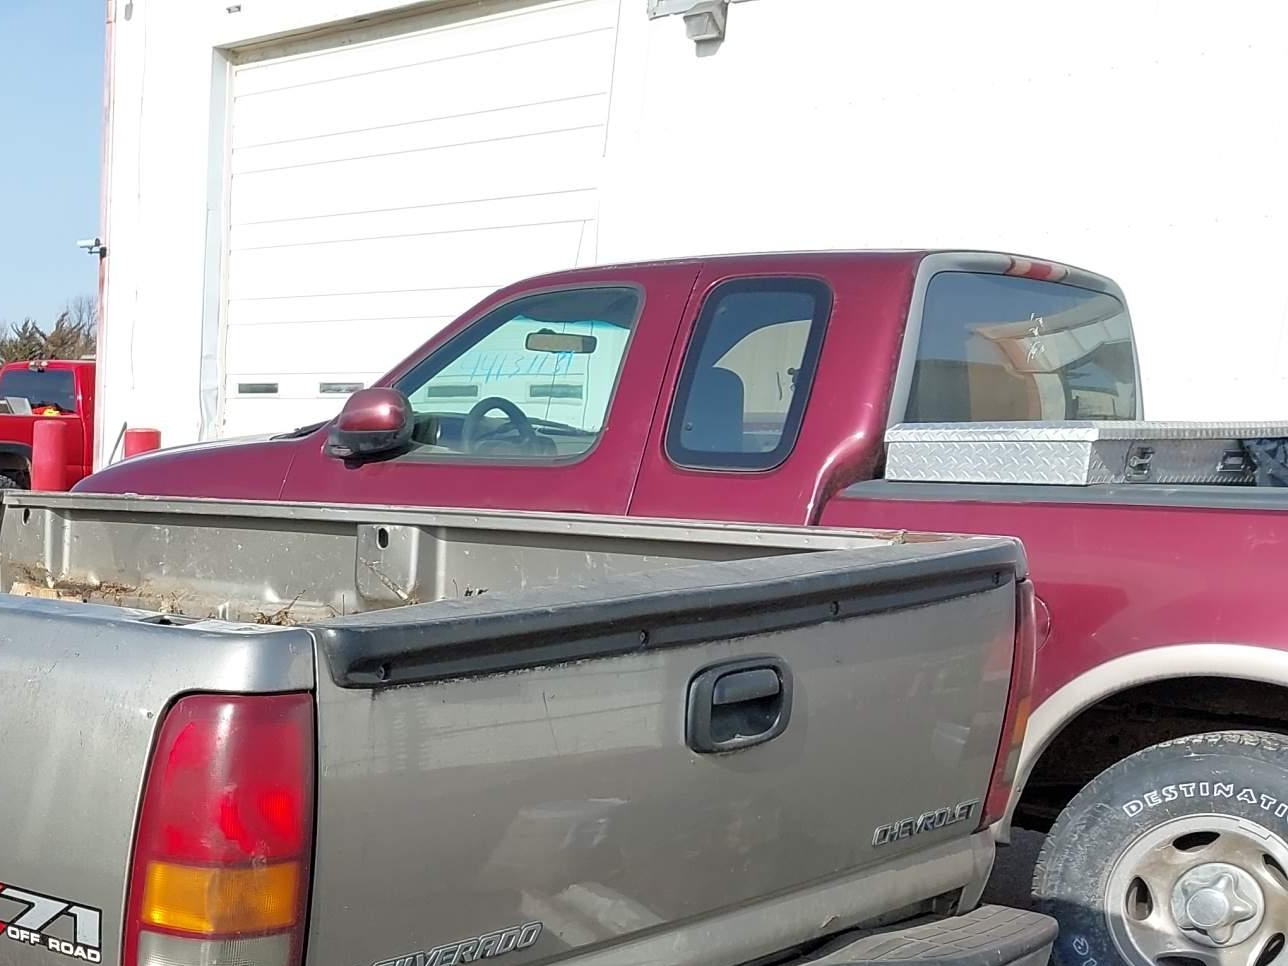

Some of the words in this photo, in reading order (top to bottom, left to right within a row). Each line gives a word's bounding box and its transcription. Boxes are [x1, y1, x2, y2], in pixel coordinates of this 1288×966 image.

[872, 798, 980, 848] CHEVROLET
[1122, 781, 1288, 824] DESTINATI
[6, 925, 41, 946] OFF
[47, 936, 102, 964] ROAD
